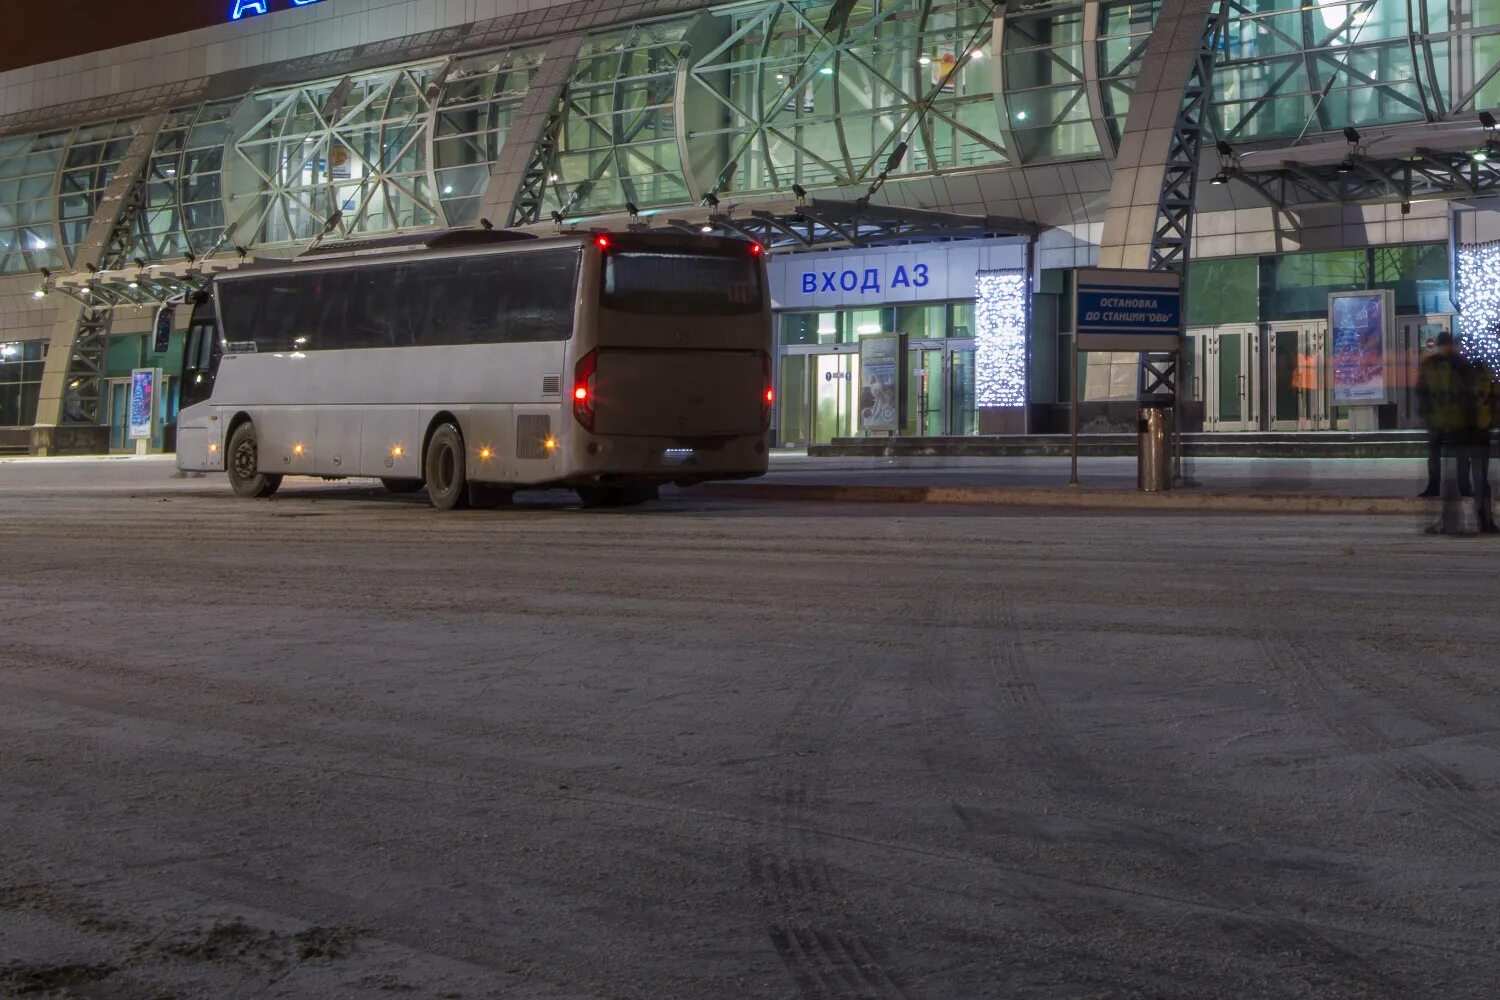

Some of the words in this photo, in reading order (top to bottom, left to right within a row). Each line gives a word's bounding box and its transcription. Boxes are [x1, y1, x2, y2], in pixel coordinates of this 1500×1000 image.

[802, 268, 880, 295] ВХОД
[891, 263, 929, 288] А3
[1100, 297, 1158, 309] ОСТАНОВКА
[1085, 311, 1100, 321] ДО
[1103, 311, 1145, 322] СТАНЦИИ
